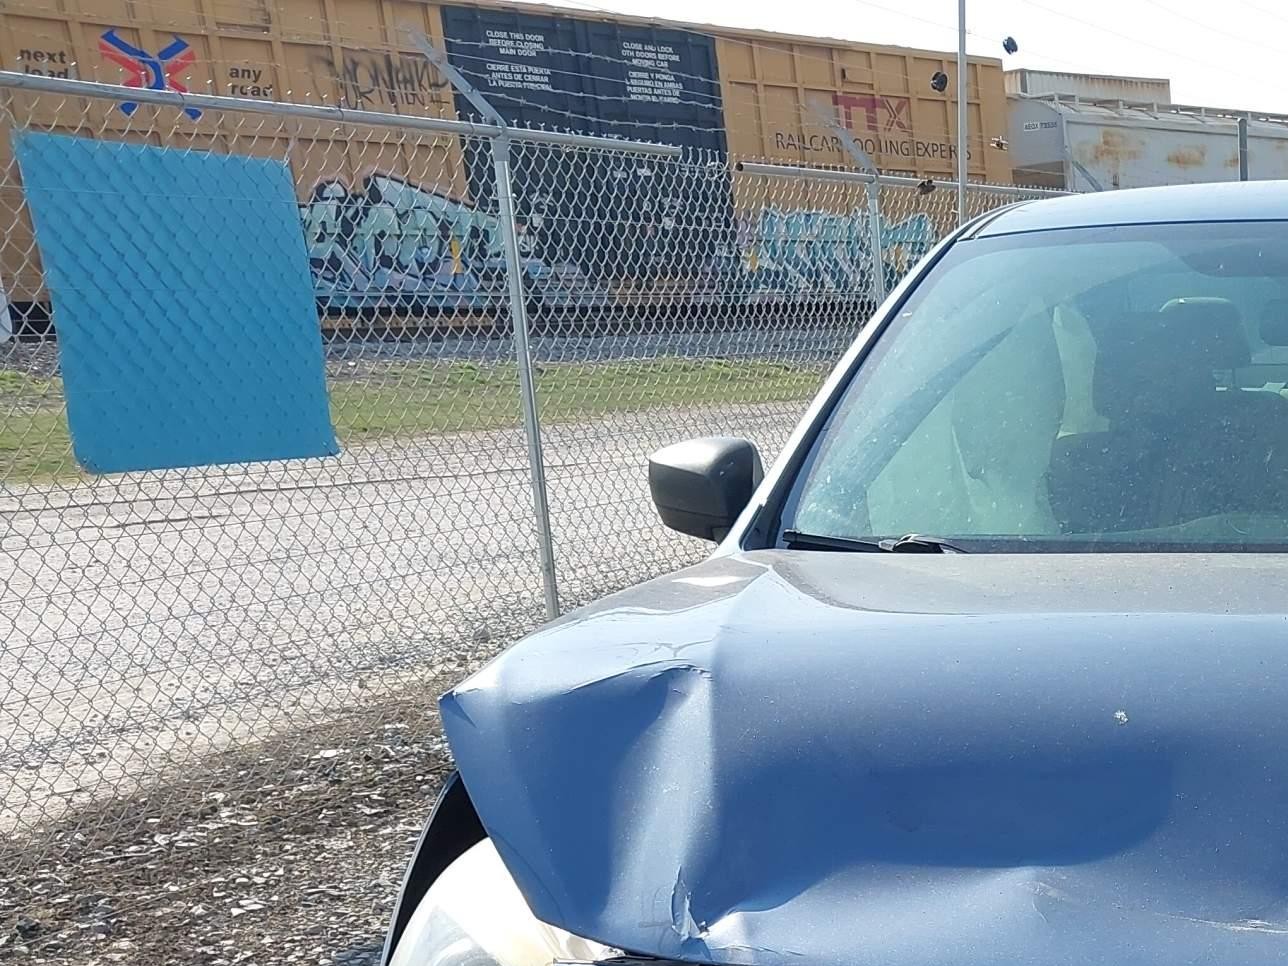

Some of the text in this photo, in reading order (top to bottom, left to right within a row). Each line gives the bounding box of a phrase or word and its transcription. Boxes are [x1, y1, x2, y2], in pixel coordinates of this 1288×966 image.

[486, 30, 544, 42] CLOSE THIS DOOR
[623, 42, 643, 50] CLOSE
[20, 48, 66, 64] next
[499, 48, 536, 57] MAIN DOOR
[635, 51, 657, 59] DOORS
[229, 67, 262, 83] any
[491, 72, 513, 80] ANTES
[775, 132, 841, 153] RAILCAR
[915, 141, 972, 161] EXPERS
